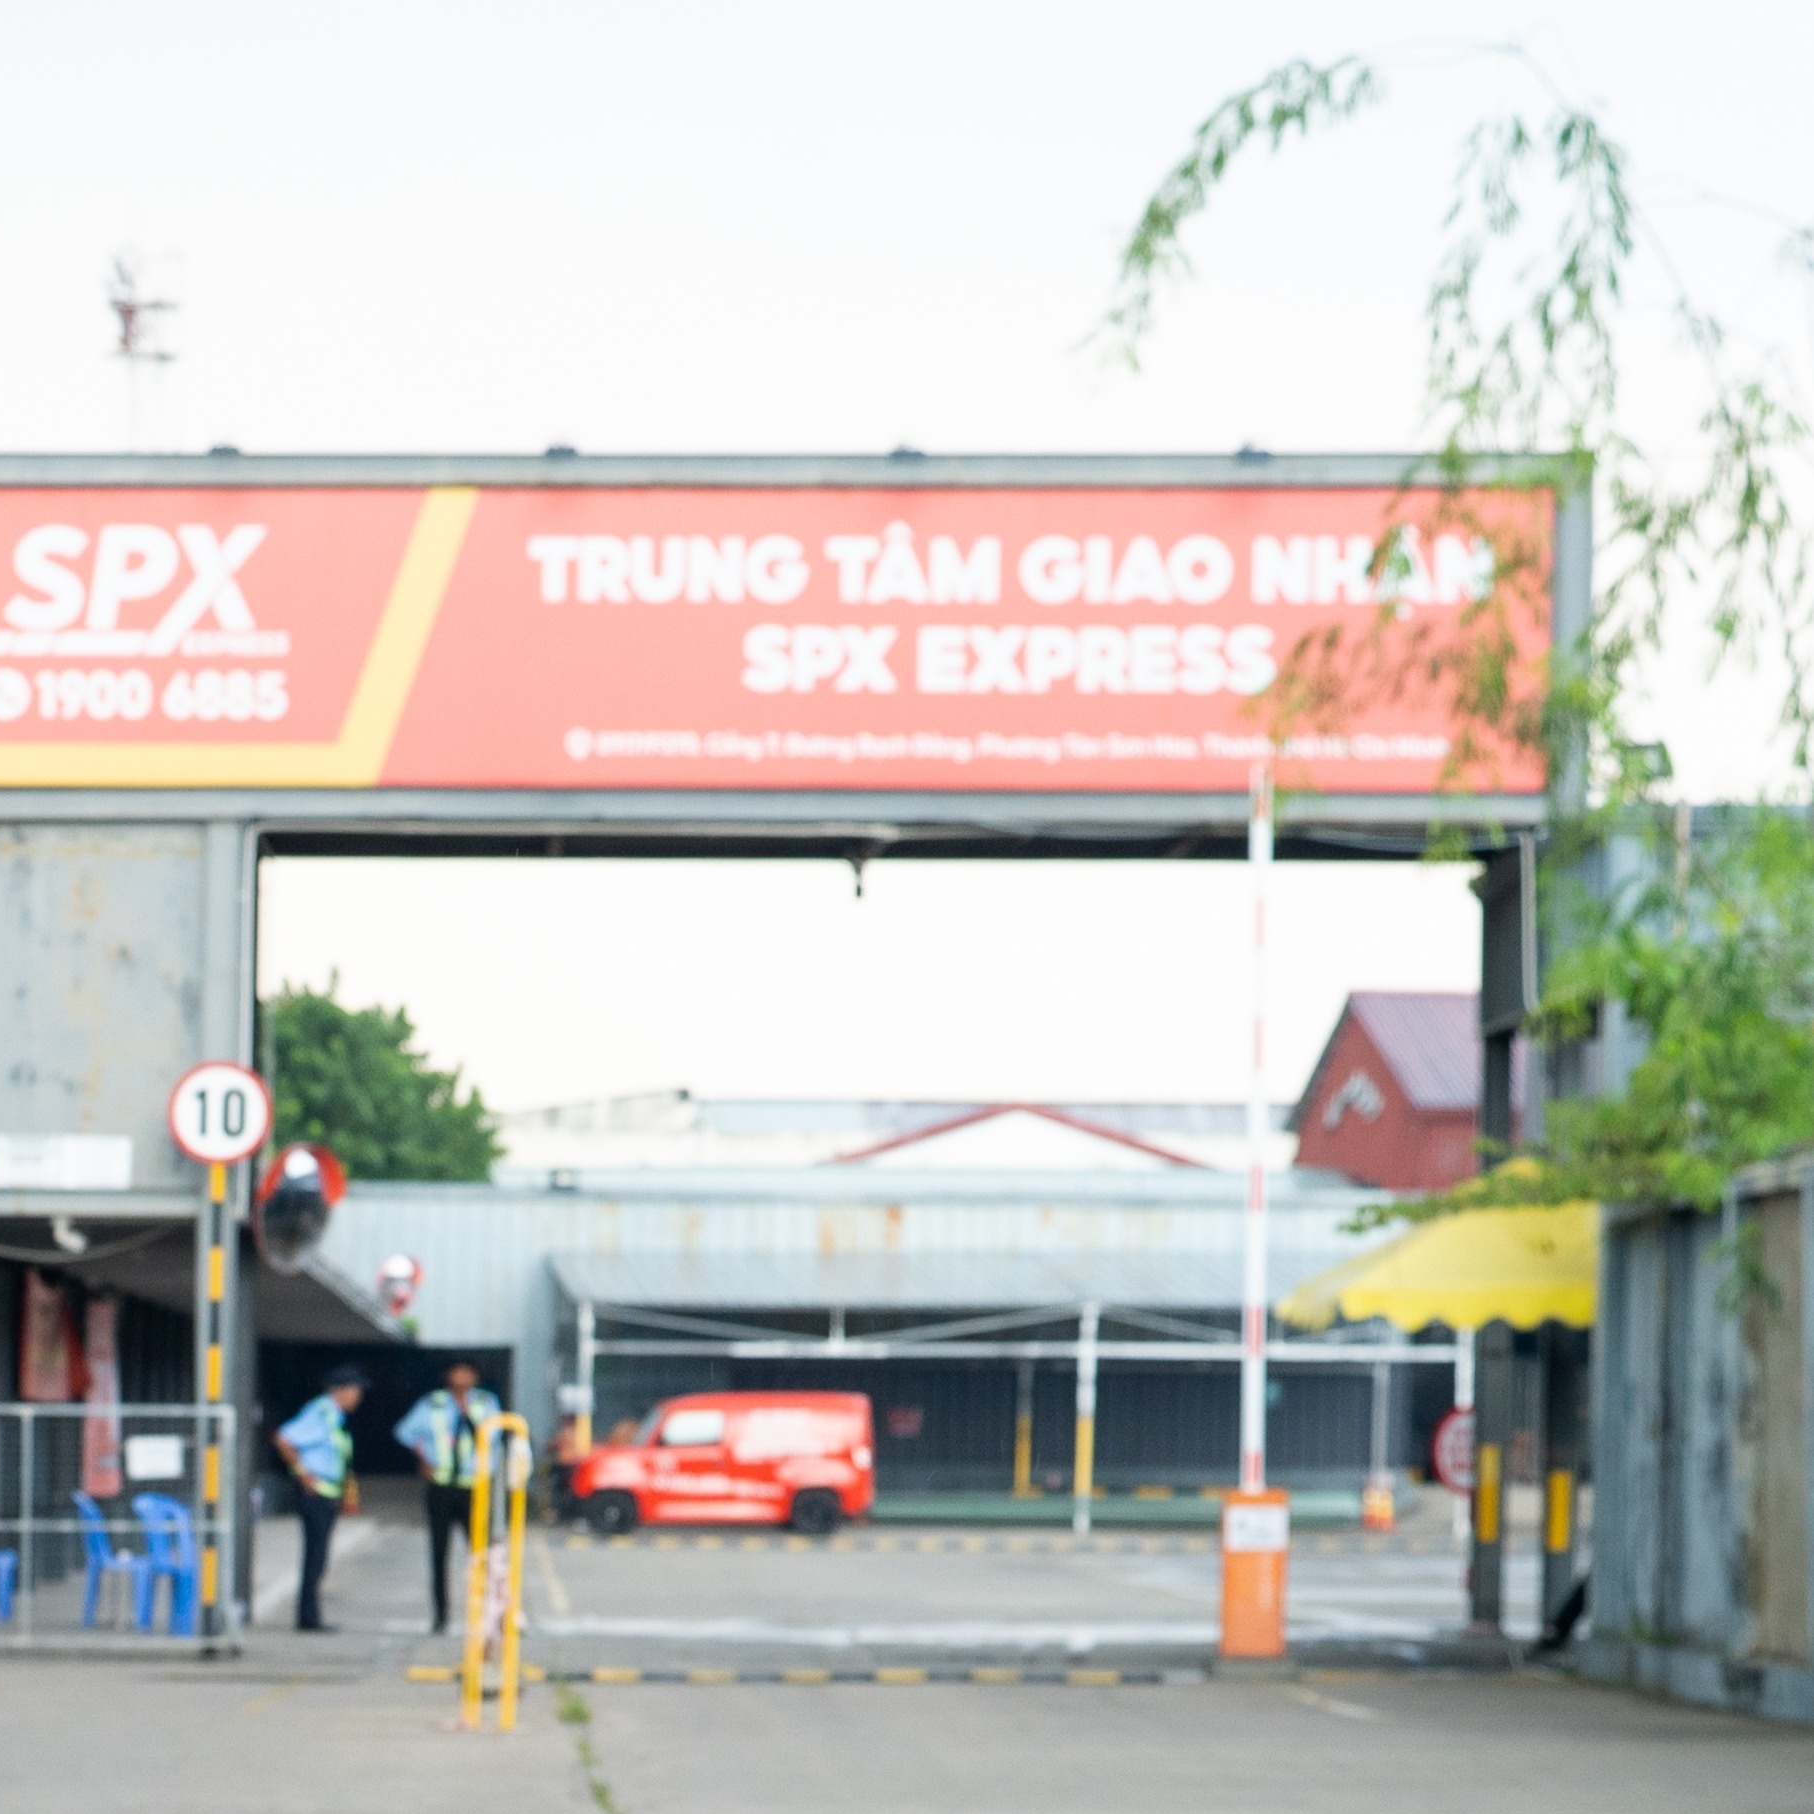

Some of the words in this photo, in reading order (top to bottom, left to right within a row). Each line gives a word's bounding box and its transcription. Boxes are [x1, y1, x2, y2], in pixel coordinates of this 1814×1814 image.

[2, 523, 269, 650] SPX
[526, 534, 810, 604] TRUNG
[823, 519, 1003, 604] TÂM
[1017, 534, 1235, 604] GIAO
[35, 668, 153, 721] 1900
[162, 668, 291, 722] 6885
[741, 623, 899, 694] SPX
[915, 623, 1277, 696] EXPRESS
[194, 1088, 246, 1138] 10
